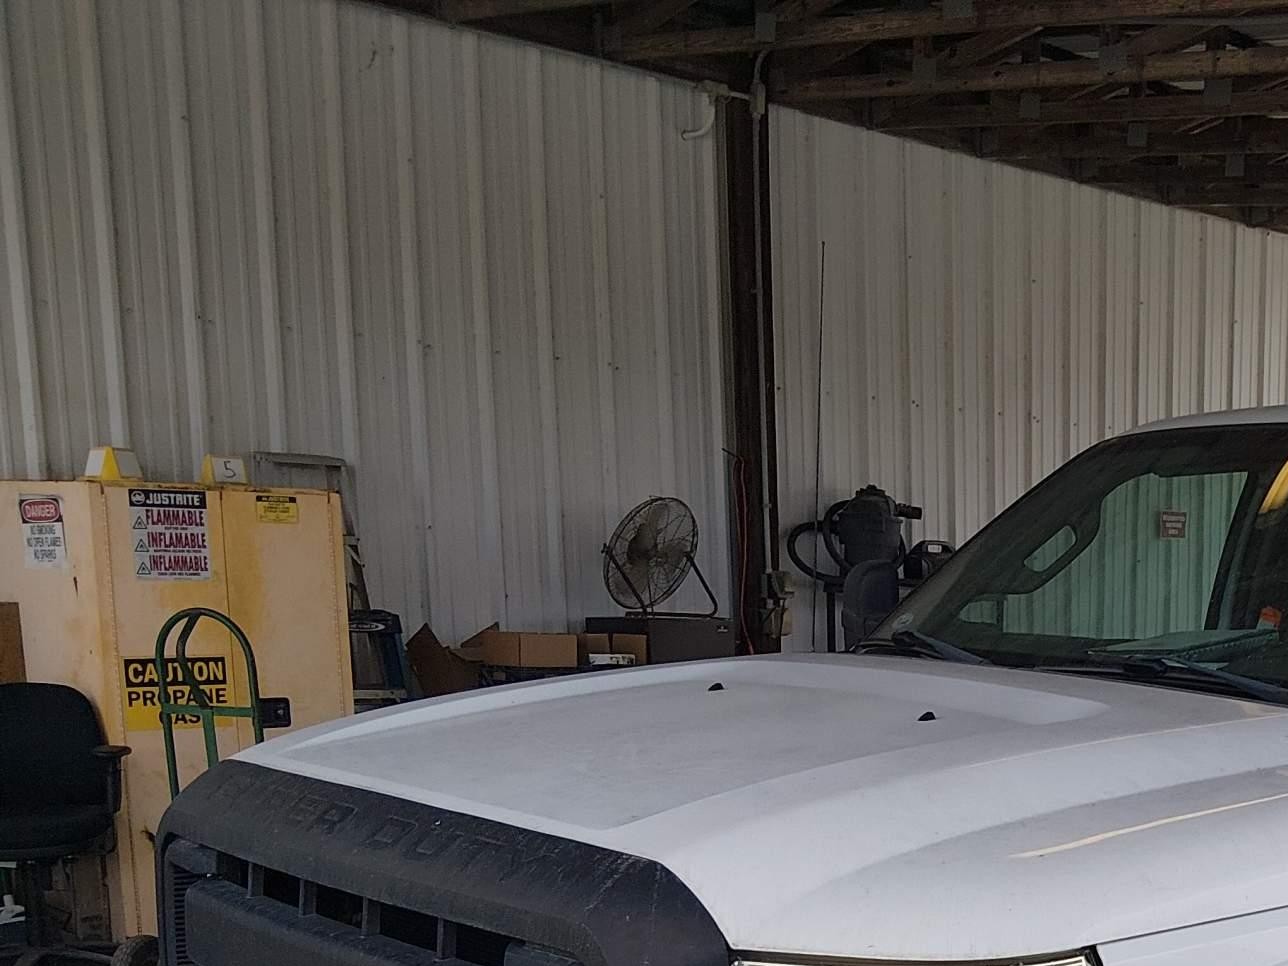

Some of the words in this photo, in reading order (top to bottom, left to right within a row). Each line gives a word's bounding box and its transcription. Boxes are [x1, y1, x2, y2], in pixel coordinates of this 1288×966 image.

[224, 460, 236, 478] 5
[146, 492, 200, 506] JUSTRITE
[25, 504, 56, 518] DANGER
[145, 509, 205, 527] FLAMMABLE
[147, 531, 207, 549] INFLAMABLE
[149, 554, 209, 572] INFLAMMABLE
[128, 661, 224, 684] CAUTON
